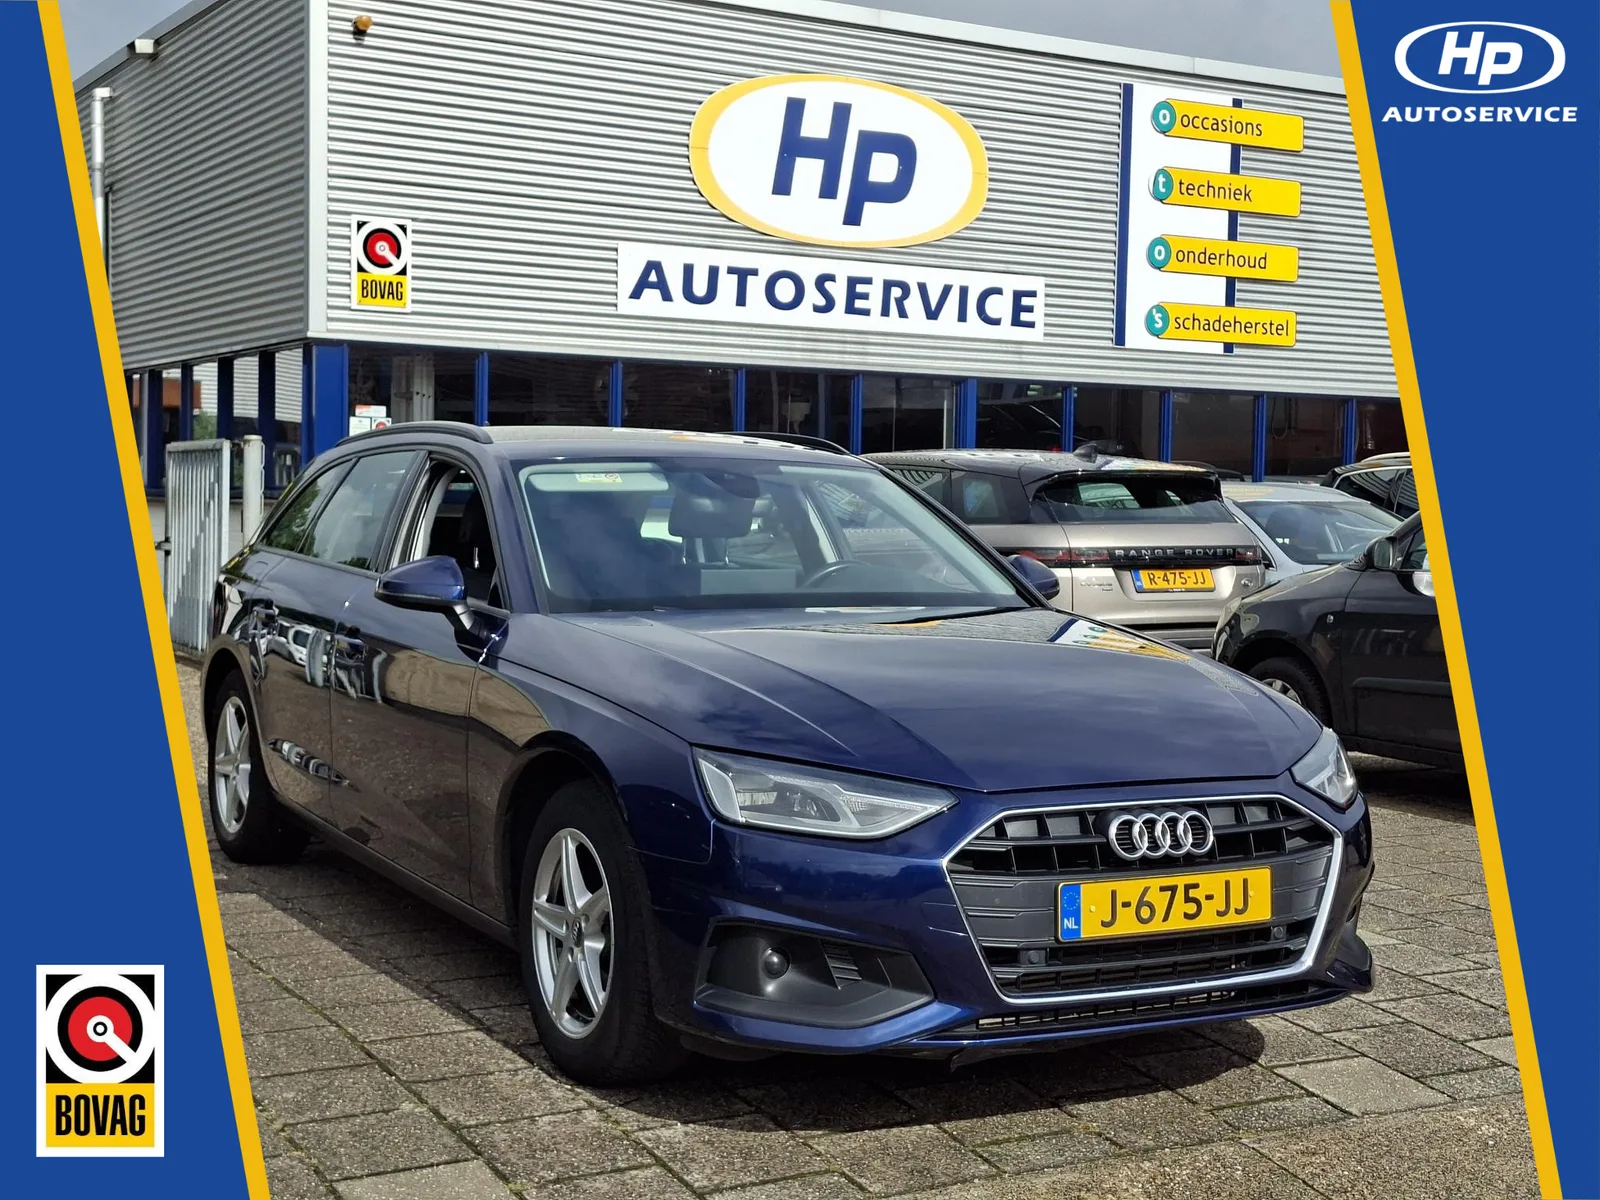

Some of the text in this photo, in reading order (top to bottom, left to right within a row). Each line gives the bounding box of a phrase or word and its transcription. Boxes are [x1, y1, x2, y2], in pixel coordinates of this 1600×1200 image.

[1159, 109, 1263, 137] o occasions
[1158, 173, 1253, 203] t techniek
[1154, 245, 1267, 270] o onderhoud
[361, 278, 404, 301] BOVAG
[628, 259, 1037, 329] AUTOSERVICE
[1174, 314, 1289, 337] schadeherstel
[1114, 548, 1233, 557] RANGE ROVER
[1147, 571, 1206, 586] R-475-JJ
[1063, 877, 1250, 929] NL J-675-JJ
